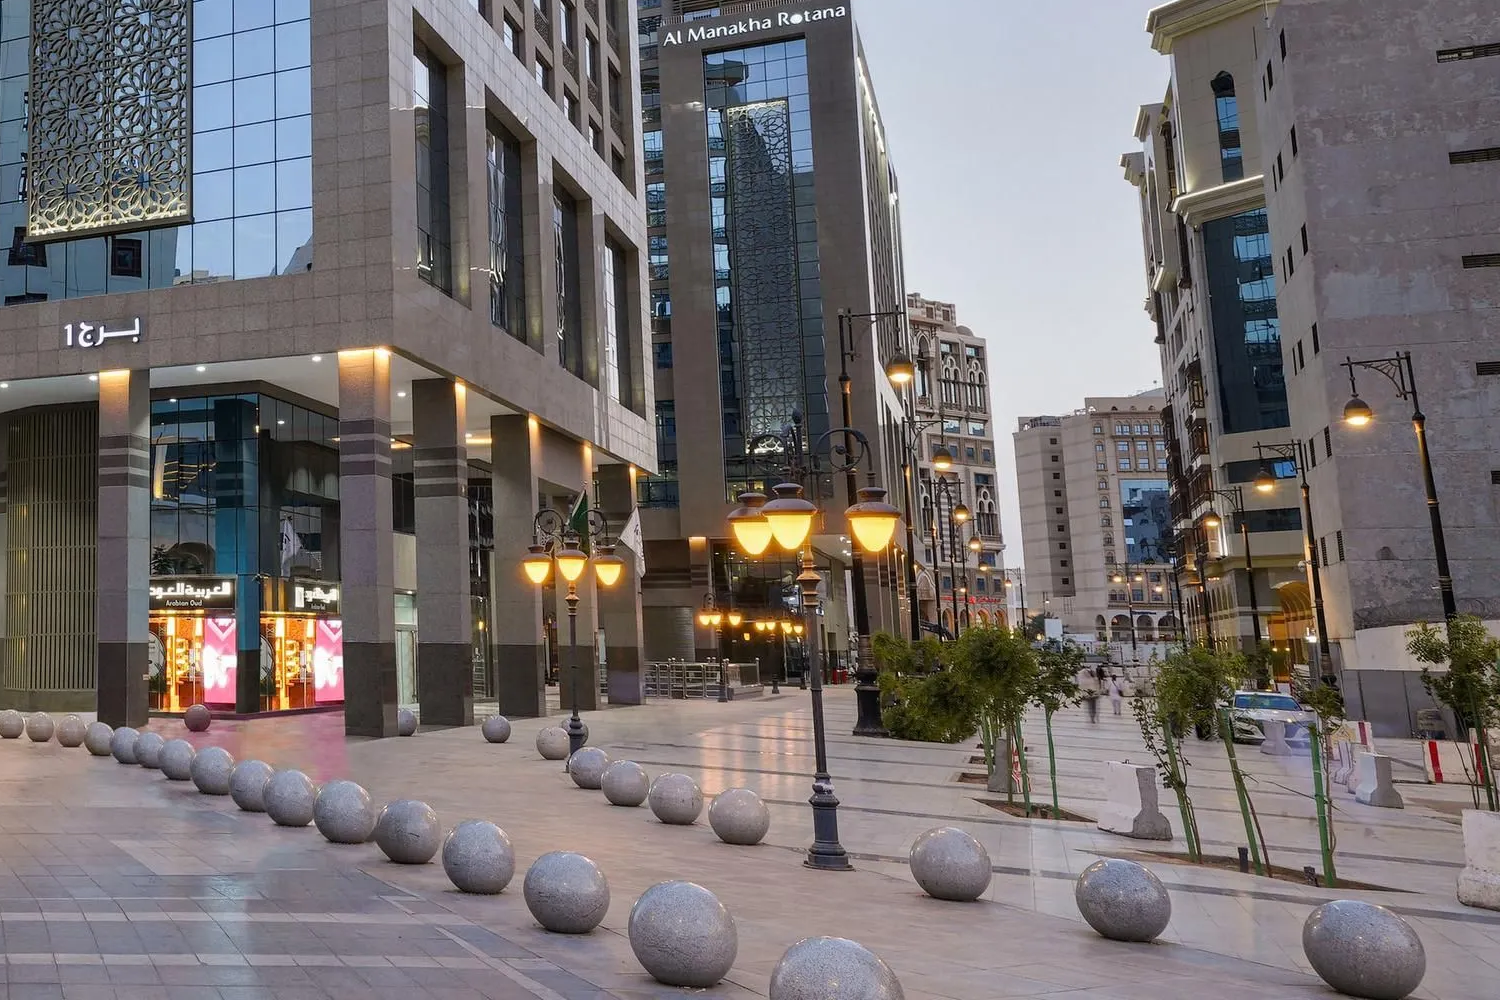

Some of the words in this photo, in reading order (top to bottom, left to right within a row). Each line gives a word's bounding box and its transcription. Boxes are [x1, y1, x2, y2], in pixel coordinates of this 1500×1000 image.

[663, 30, 682, 46] Al
[687, 18, 771, 43] Manakha
[777, 5, 846, 27] Rotana
[64, 323, 73, 346] 1
[78, 317, 140, 348] برج
[185, 582, 231, 599] العربية
